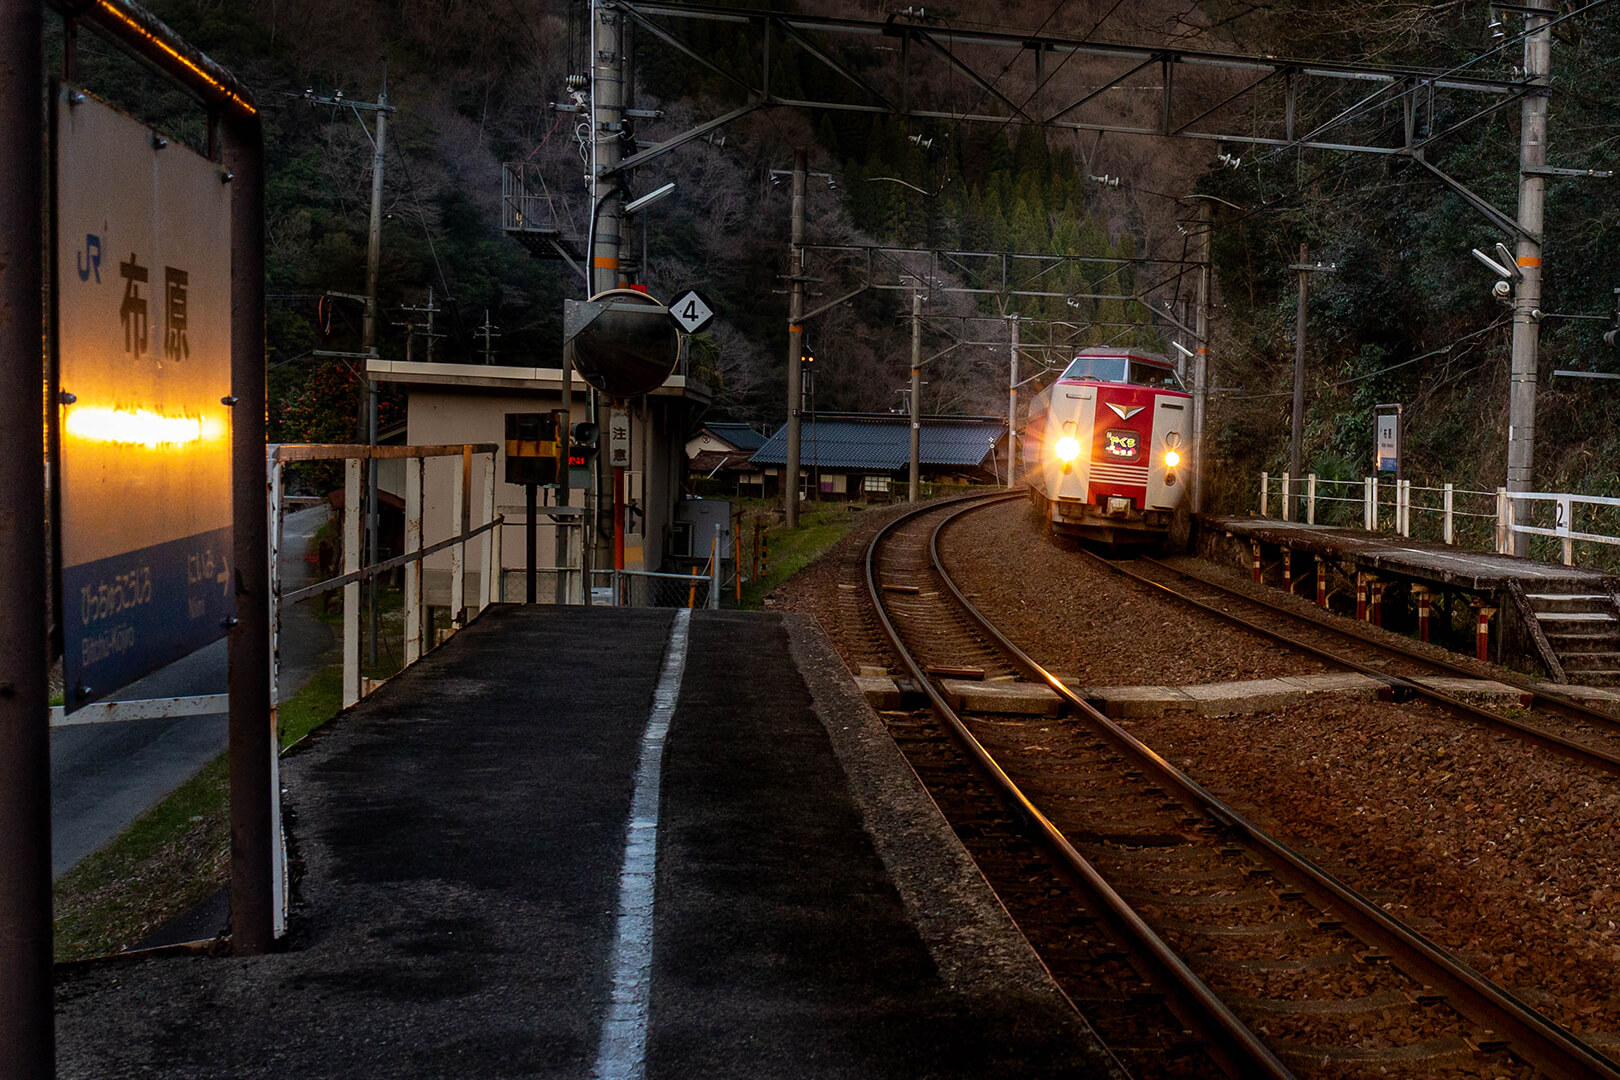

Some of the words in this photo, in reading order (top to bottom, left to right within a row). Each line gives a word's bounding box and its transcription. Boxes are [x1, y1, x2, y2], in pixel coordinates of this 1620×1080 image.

[77, 233, 102, 285] JR
[119, 251, 190, 362] 布原
[682, 300, 699, 322] 4
[612, 427, 627, 462] 注意
[1557, 502, 1564, 528] 2
